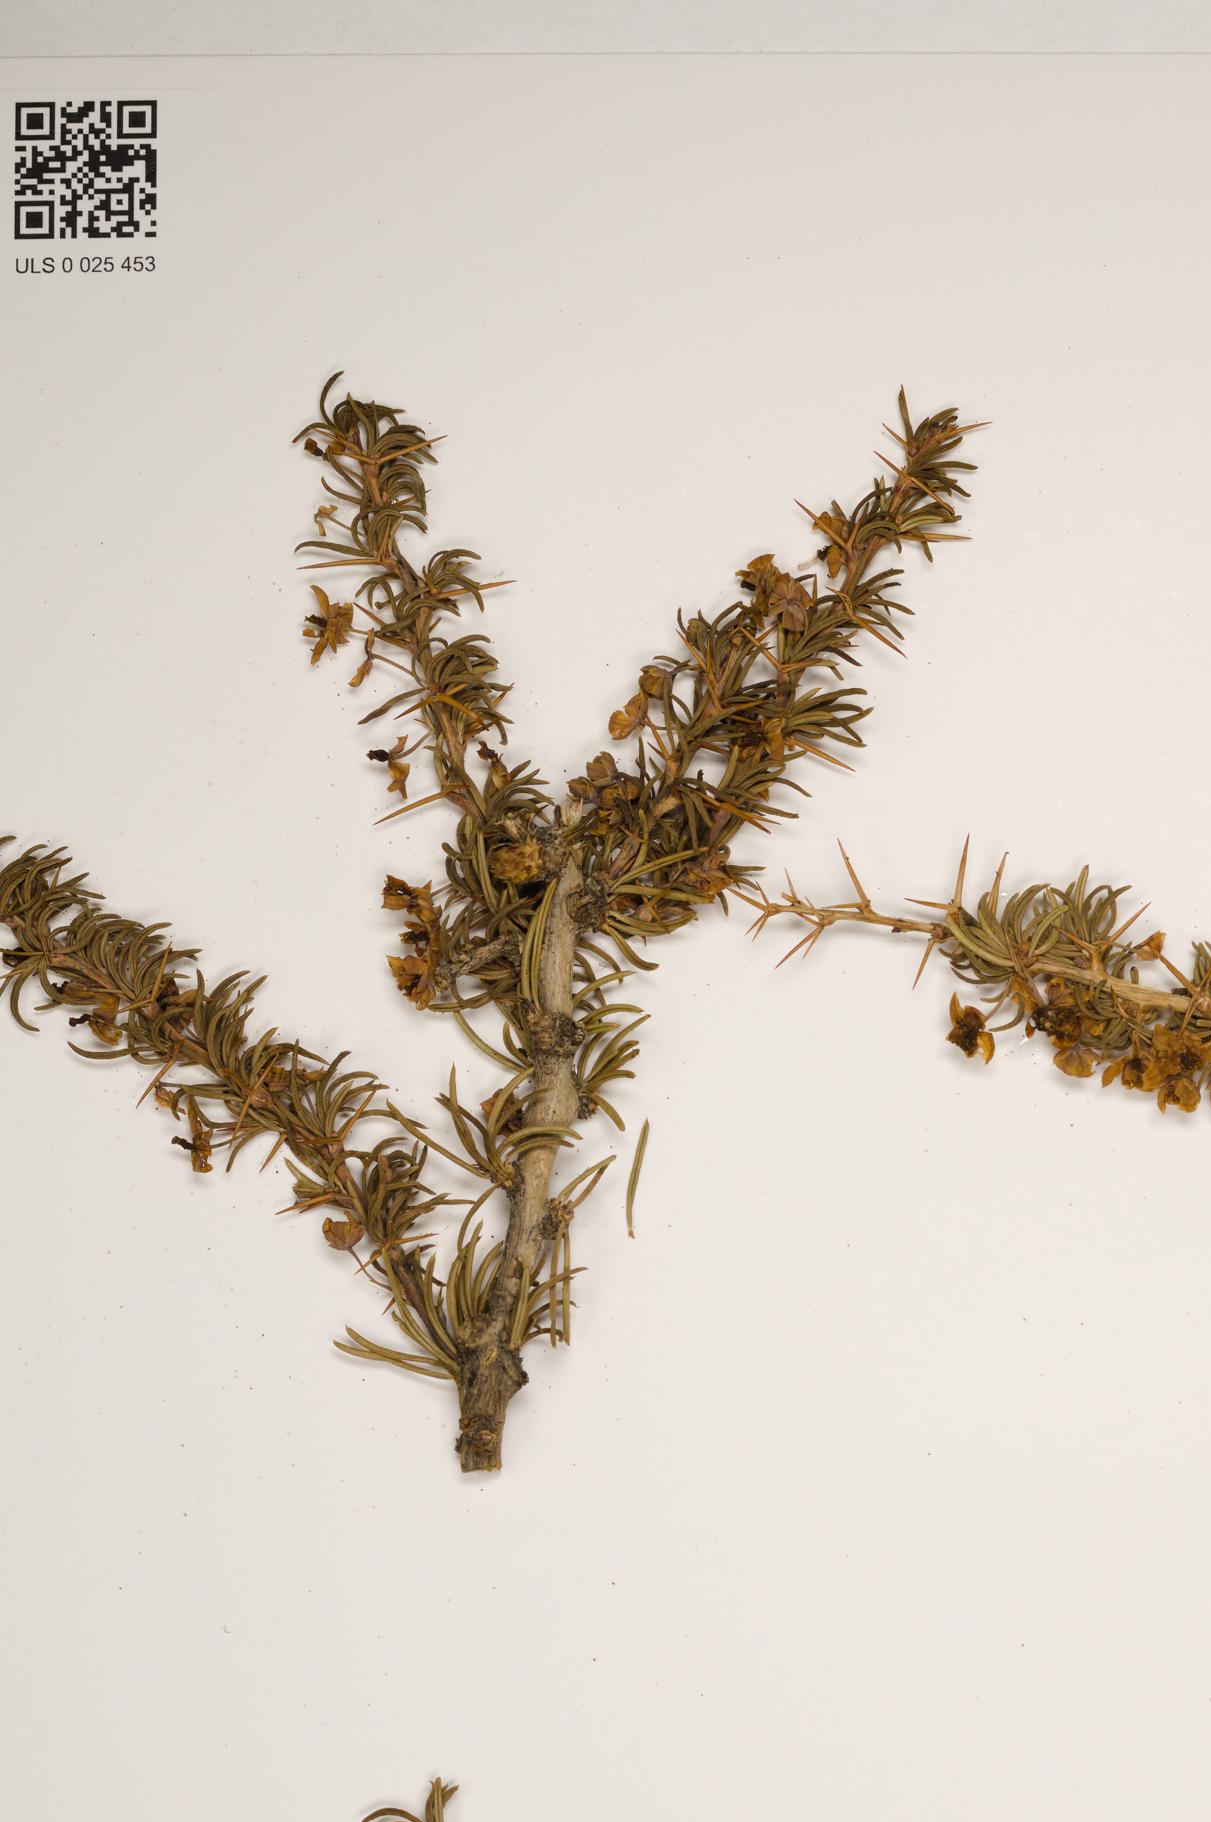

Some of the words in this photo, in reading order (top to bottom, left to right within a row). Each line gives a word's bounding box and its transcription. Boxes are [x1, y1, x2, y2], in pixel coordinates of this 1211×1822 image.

[16, 257, 55, 274] ULS
[62, 257, 73, 273] 0
[80, 257, 114, 272] 025
[121, 256, 156, 272] 453
